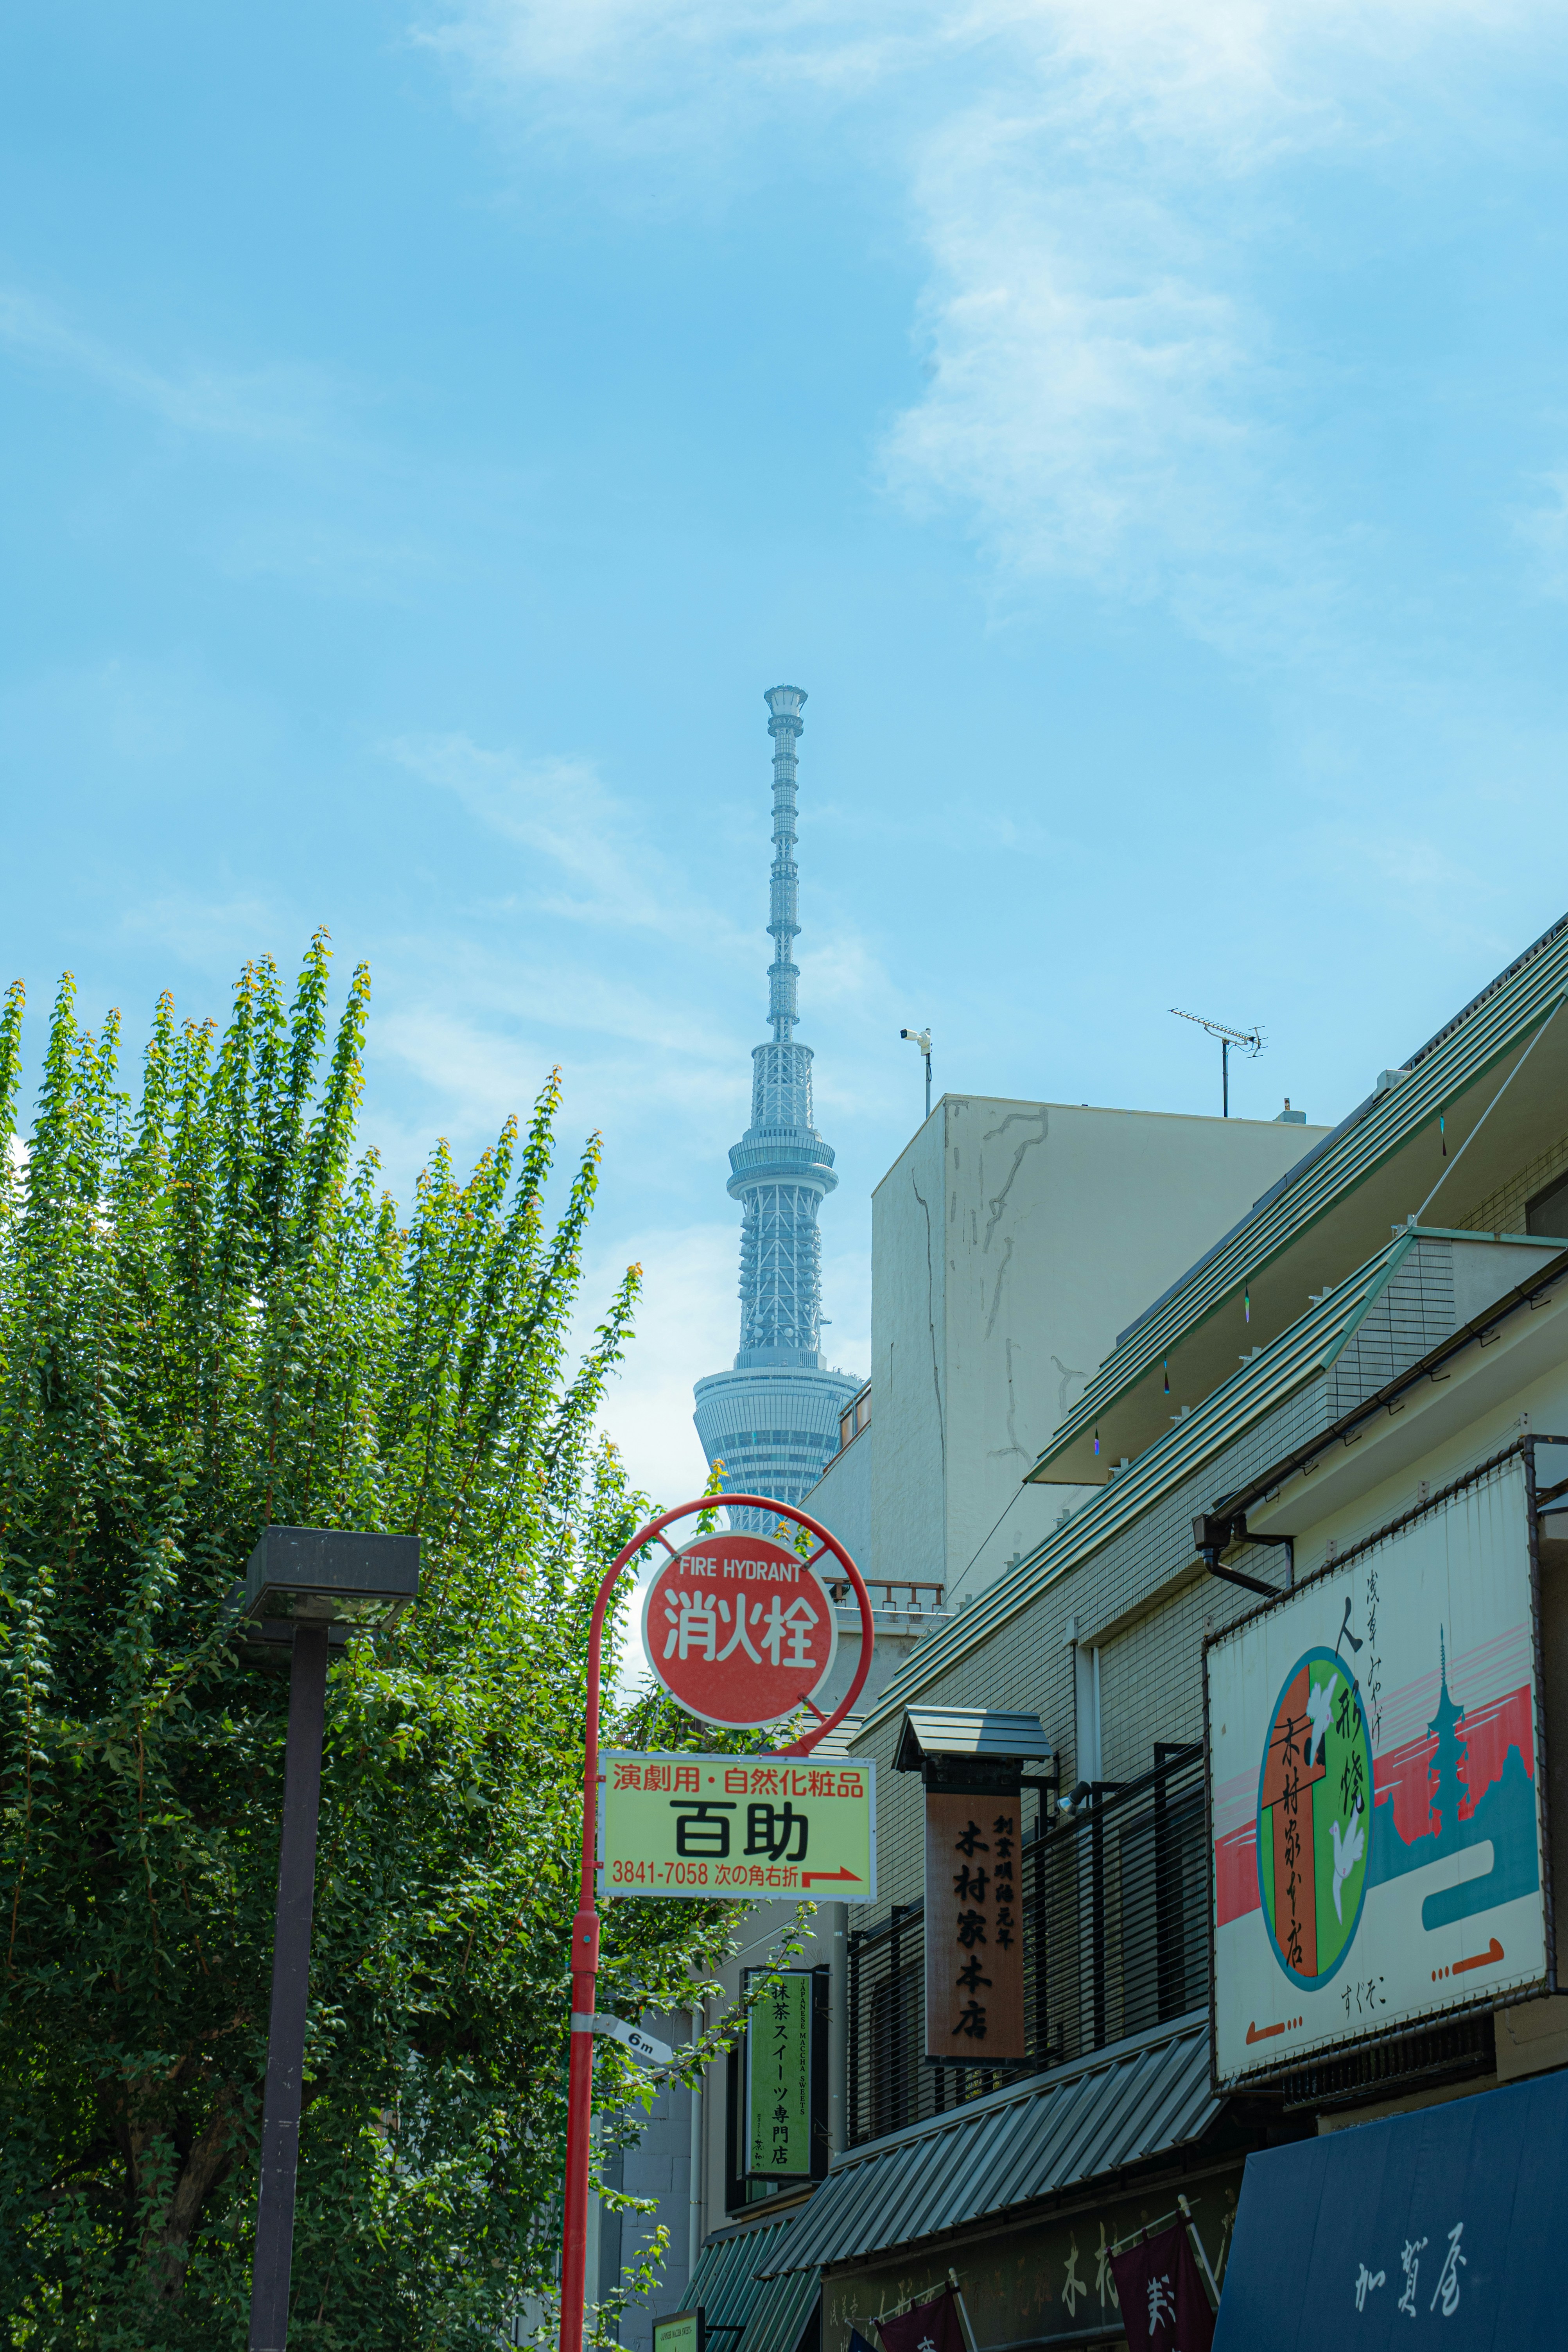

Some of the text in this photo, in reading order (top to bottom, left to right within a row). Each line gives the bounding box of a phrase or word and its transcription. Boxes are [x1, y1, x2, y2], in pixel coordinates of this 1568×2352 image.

[679, 1556, 802, 1583] FIRE HYDRANT
[663, 1589, 819, 1668] 消火栓
[1366, 1570, 1381, 1750] 浅草みやげ
[1335, 1596, 1365, 1817] 人形焼
[613, 1763, 863, 1798] 演劇用・自然化粧品
[669, 1801, 808, 1862] 百助
[1283, 1718, 1302, 1968] 木村家本店
[613, 1860, 799, 1887] 3841-7058 次の角右折
[994, 1815, 1014, 1950] 創業明治元年
[951, 1820, 992, 2039] 木村家本店
[1342, 1977, 1385, 2019] すぐそこ
[628, 2033, 653, 2054] 6m
[771, 1982, 790, 2165] 抹茶スイーツ専門店
[1355, 2222, 1467, 2318] 加賀屋
[661, 2326, 691, 2341] JAPANESE MACCHA SWEETS
